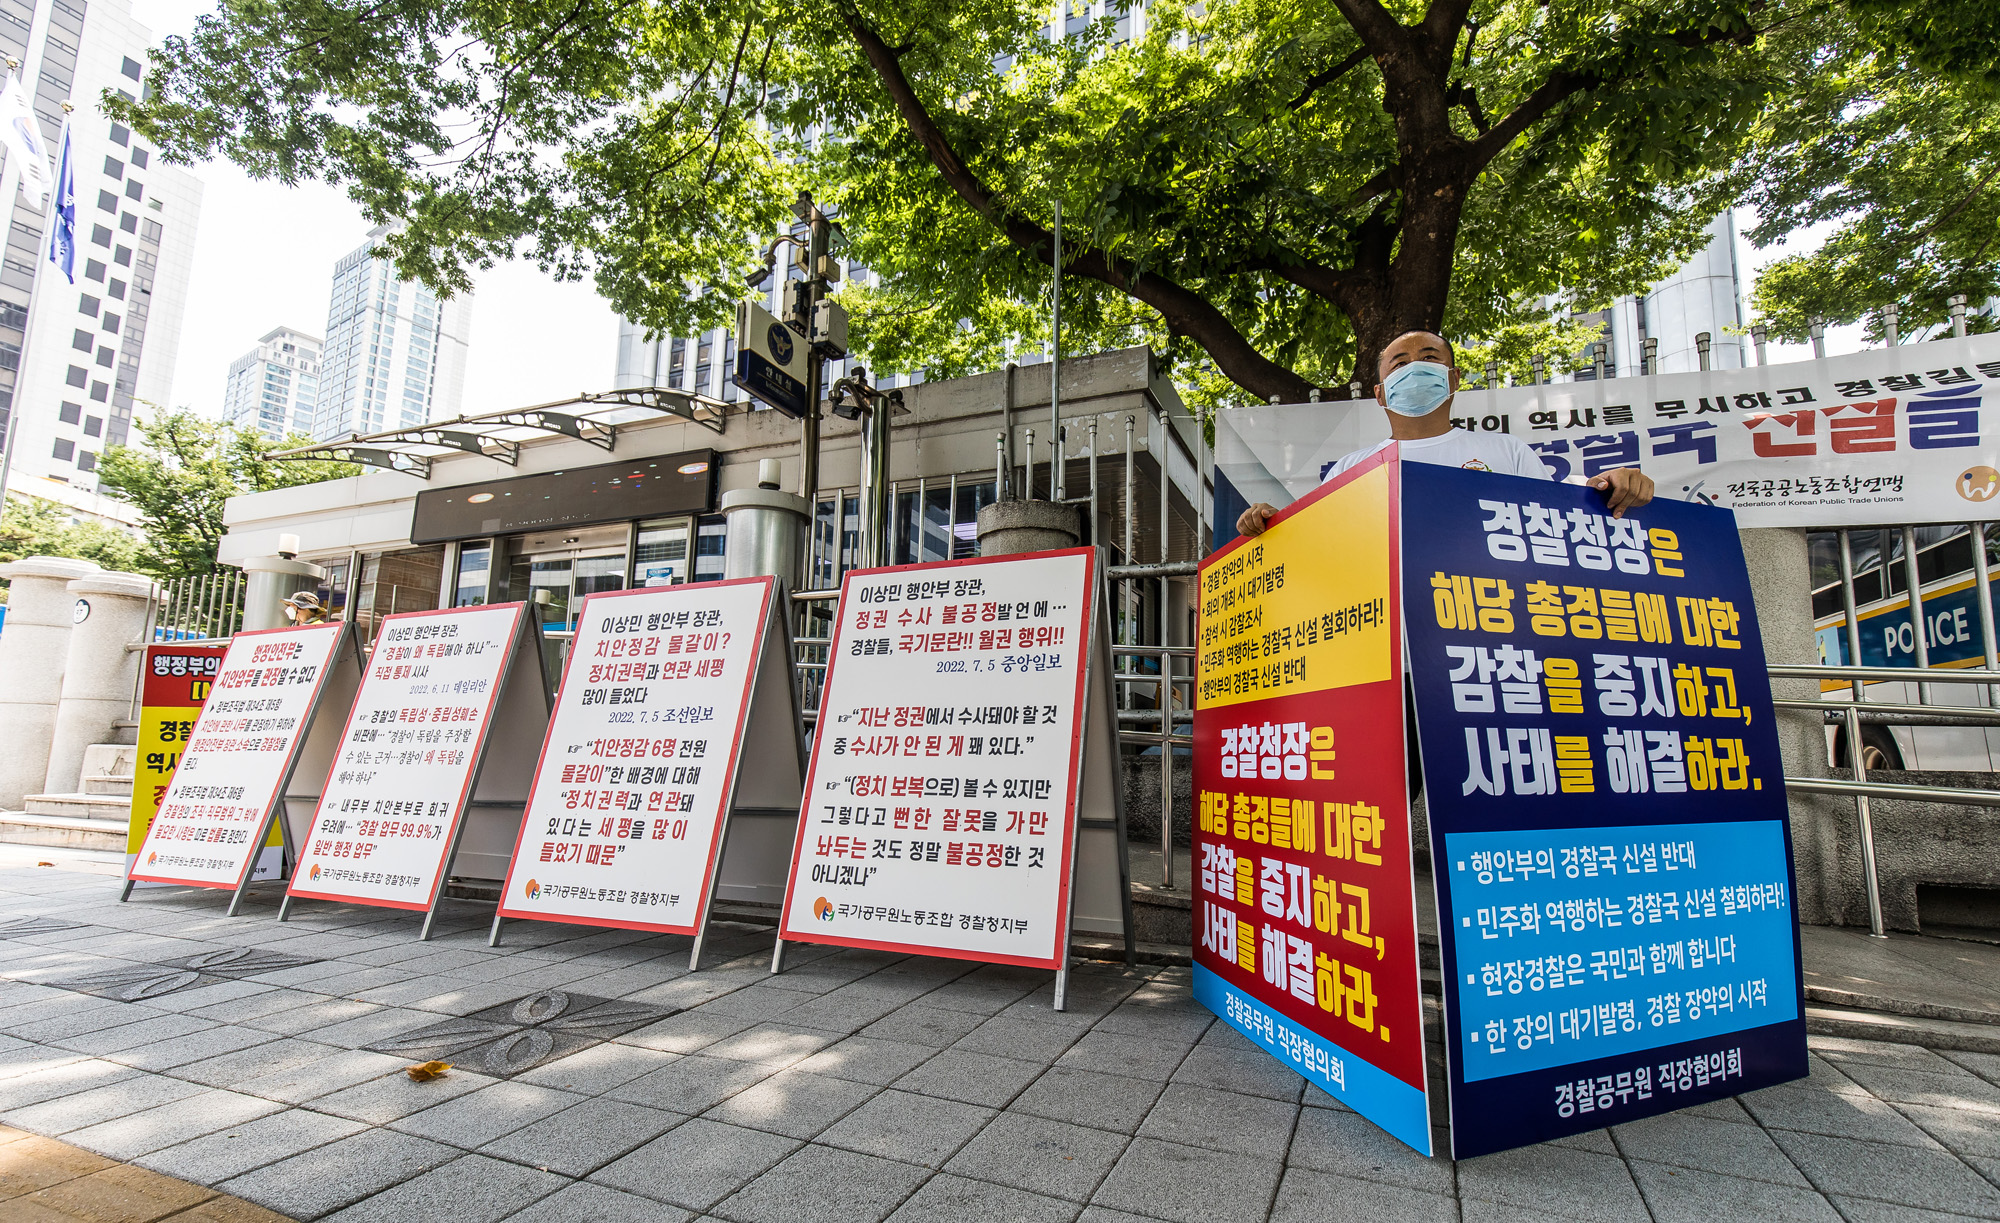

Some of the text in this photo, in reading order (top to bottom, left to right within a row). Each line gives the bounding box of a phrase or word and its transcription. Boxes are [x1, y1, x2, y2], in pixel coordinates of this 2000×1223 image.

[1528, 404, 1635, 431] 역사를
[1655, 387, 1817, 419] 무시하고
[1742, 384, 1983, 457] 신설을
[1727, 474, 1904, 498] 전국공공노동조합연맹
[1732, 500, 1775, 508] Federation
[1789, 498, 1817, 506] Korean
[1819, 497, 1845, 505] Public
[1478, 498, 1685, 578] 경찰청장은
[1207, 543, 1265, 593] 경찰 장악의 시작
[859, 579, 986, 604] 이상민 행안부 장관,
[1206, 563, 1286, 619] 회의 개최 시 대기발령
[601, 609, 723, 634] 이상민 행안부 장관,
[855, 609, 888, 630] 정권
[897, 607, 933, 628] 수사
[1429, 570, 1742, 650] 해당 총경들에 대한
[387, 624, 459, 642] 이상민 행안부 장관,
[594, 632, 731, 658] 치안정감 물갈이?
[850, 626, 1065, 656] 경찰들, 국기문란!! 월권 행위!!
[1204, 597, 1384, 674] 민주화 역행하는 경찰국 신설 철회하라!
[1884, 606, 1970, 657] POICE
[251, 641, 304, 664] 행정안전부는
[219, 669, 263, 689] 치안업무를
[261, 667, 289, 686] 관장할
[288, 667, 298, 684] 수
[375, 664, 429, 681] 직접 통제 시사
[588, 658, 725, 684] 정치권력과 연관 세평
[1203, 655, 1306, 701] 행안부의 경찰국 신설 반대
[1445, 644, 1752, 727] 감찰을 중지하고,
[893, 706, 955, 727] 정권에서
[958, 705, 1019, 725] 수사돼야
[1022, 705, 1039, 725] 할
[1042, 705, 1058, 724] 것
[651, 738, 677, 758] 6명
[678, 739, 707, 758] 전원
[834, 737, 847, 755] 중
[850, 736, 899, 756] 수사가
[903, 736, 921, 756] 안
[925, 736, 942, 756] 된
[946, 736, 964, 756] 게
[968, 736, 982, 756] 꽤
[1220, 720, 1336, 781] 경찰청장은
[1462, 726, 1763, 797] 사태를 해결하라.
[626, 766, 669, 785] 배경에
[671, 766, 701, 785] 대해
[890, 776, 960, 799] 보복으로)
[963, 778, 979, 798] 볼
[982, 779, 998, 798] 수
[1002, 779, 1052, 800] 있지만
[341, 798, 450, 818] 내무부 치안본부로 회귀
[647, 791, 695, 812] 연관돼
[546, 817, 688, 841] 있다는 세평을 많이
[821, 805, 1048, 836] 그렇다고 뻔한 잘못을 가만
[1199, 789, 1386, 867] 해당 총경들에 대한
[539, 841, 583, 864] 들었기
[816, 835, 1045, 869] 놔두는 것도 정말 불공정한 것
[1470, 840, 1697, 885] 행안부의 경찰국 신설 반대
[322, 868, 420, 888] 국가공무원노동조합 경찰청지부
[543, 884, 680, 907] 국가공무원노동조합 경찰청지부
[1201, 841, 1385, 962] 감찰을 중지하고,
[1477, 882, 1785, 940] 민주화 역행하는 경찰국 신설 철회하라!
[837, 903, 1028, 935] 국가공무원노동조합 경찰청지부
[1201, 900, 1390, 1043] 사태를 해결하라.
[1480, 934, 1737, 997] 현장경찰은 국민과 함께 합니다
[1485, 978, 1768, 1055] 한 장의 대기발령, 경찰 장악의 시작
[1225, 990, 1346, 1092] 경찰공무원 직장협의회
[1554, 1047, 1744, 1119] 경찰공무원 직장협의회
